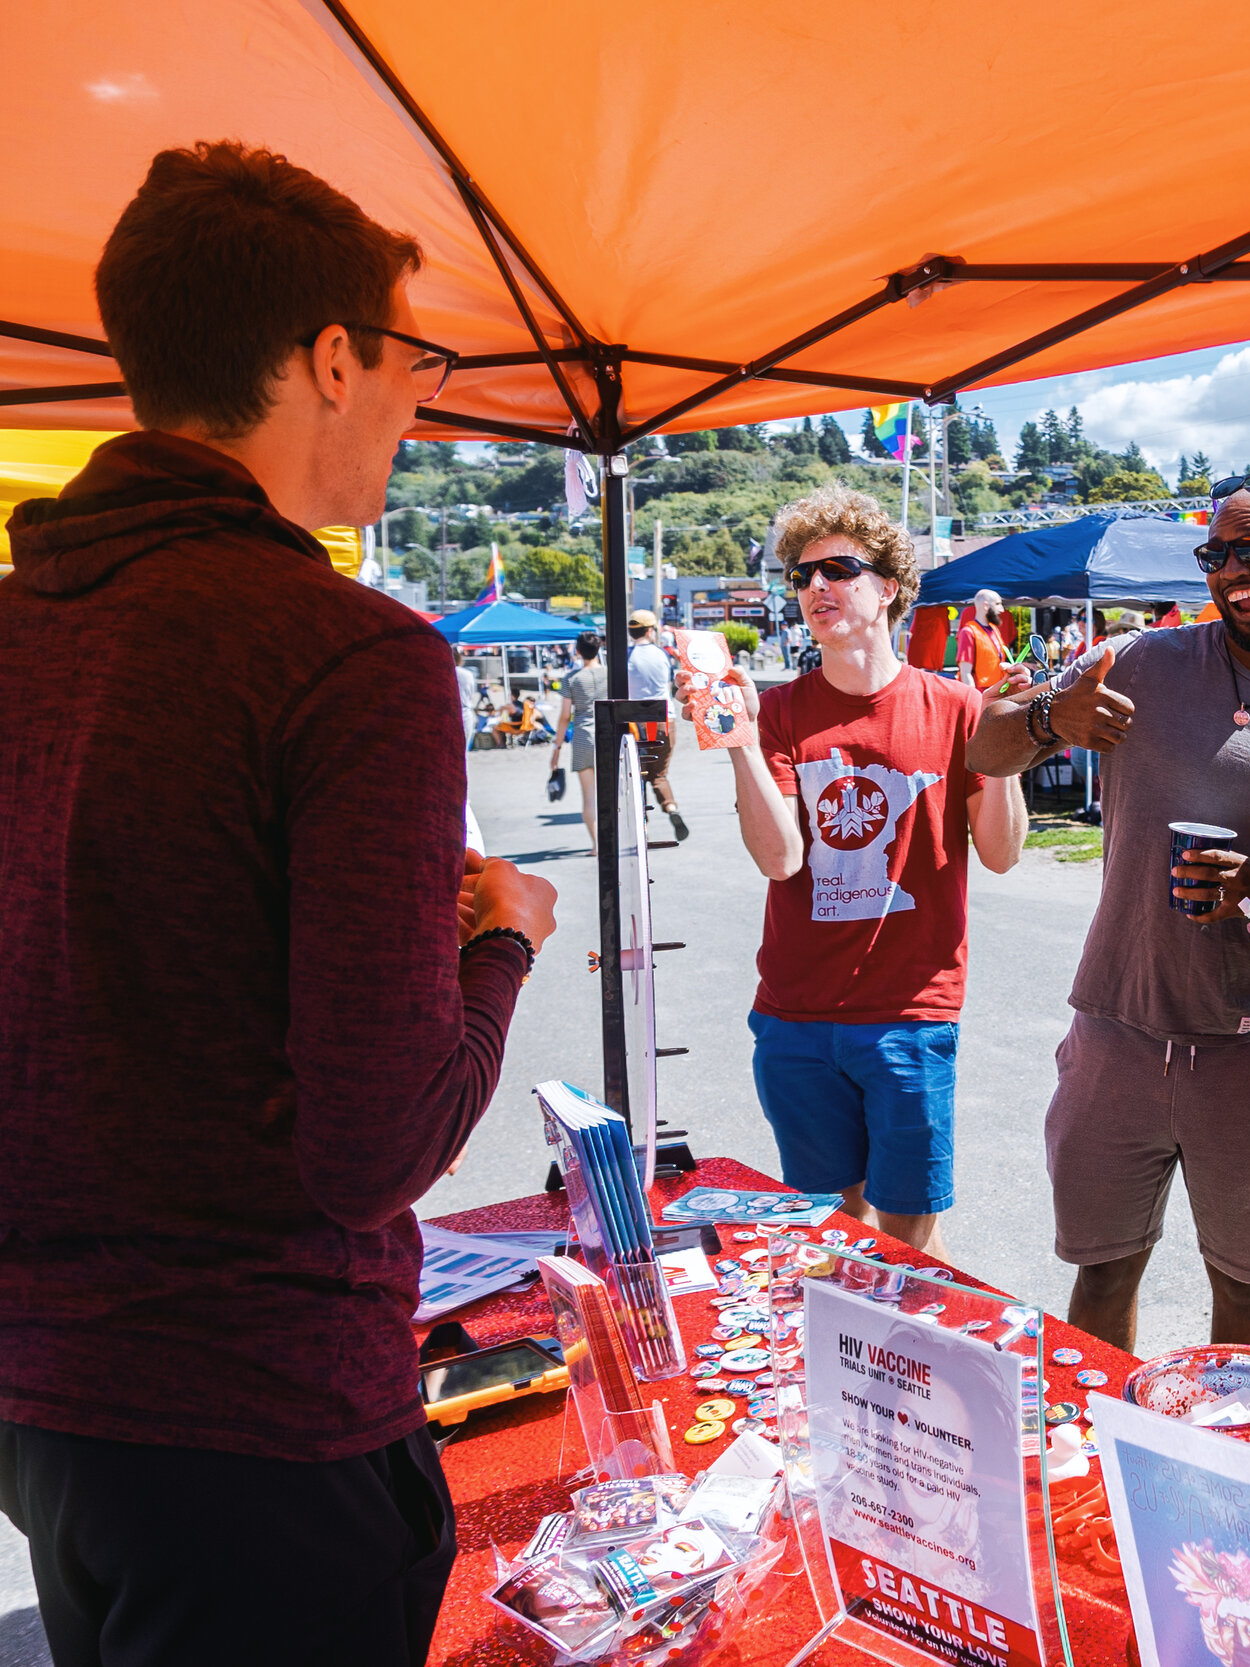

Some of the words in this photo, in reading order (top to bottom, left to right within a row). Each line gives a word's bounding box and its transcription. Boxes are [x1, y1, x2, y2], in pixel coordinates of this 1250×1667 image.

[816, 873, 846, 887] real.
[816, 886, 894, 904] indigenous
[817, 905, 840, 917] art.
[839, 1333, 863, 1359] HIV
[867, 1343, 932, 1386] VACCINE
[840, 1356, 866, 1375] TRIALS
[868, 1367, 886, 1383] UNIT
[897, 1378, 931, 1400] SEATTLE
[841, 1390, 868, 1410] SHOW
[870, 1401, 895, 1421] YOUR
[914, 1419, 975, 1452] VOLUNTEER.
[843, 1418, 855, 1430] We
[857, 1425, 869, 1437] are
[871, 1428, 899, 1451] looking
[900, 1441, 911, 1454] for
[913, 1449, 964, 1475] HIV-negative
[864, 1442, 893, 1460] women
[894, 1454, 909, 1468] and
[911, 1460, 932, 1478] trans
[933, 1469, 981, 1498] individuals,
[870, 1457, 891, 1474] years
[892, 1466, 905, 1479] old
[906, 1471, 918, 1485] for
[919, 1479, 925, 1488] a
[926, 1481, 944, 1497] paid
[946, 1488, 961, 1502] HIV
[877, 1474, 900, 1491] study.
[850, 1492, 914, 1528] 206-667-2300
[853, 1508, 977, 1571] www.seattlevaccines.org
[861, 1559, 1010, 1653] SEATTLE
[864, 1608, 909, 1636] Volunteer
[910, 1630, 925, 1645] for
[926, 1638, 940, 1651] an
[940, 1644, 959, 1659] HIV
[872, 1597, 917, 1627] SHOW
[921, 1619, 964, 1650] YOUR
[967, 1641, 1007, 1667] LOVE
